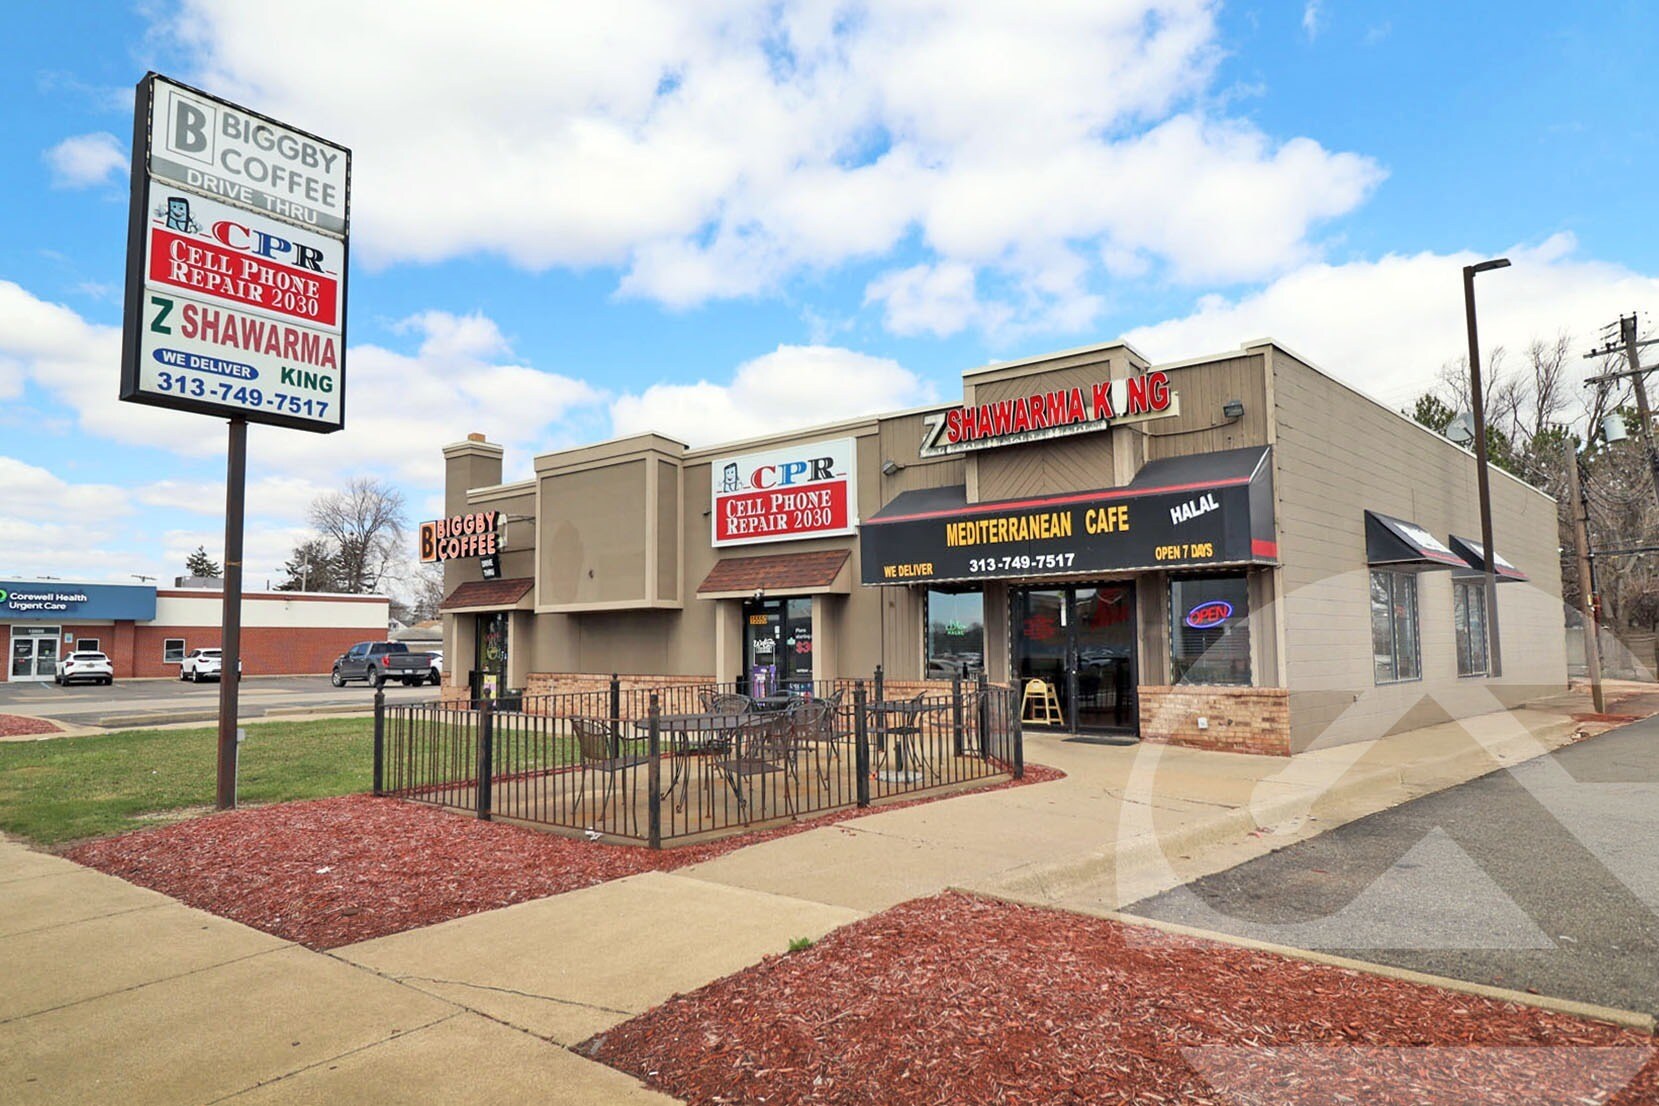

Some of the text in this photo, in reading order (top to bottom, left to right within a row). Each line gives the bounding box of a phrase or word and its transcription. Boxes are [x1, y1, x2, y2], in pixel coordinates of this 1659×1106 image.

[175, 100, 207, 152] B
[222, 112, 337, 174] BIGGBY
[220, 148, 336, 208] COFFEE
[187, 169, 317, 224] DRIVE THRU
[212, 220, 325, 273] CPR
[271, 289, 319, 317] 2030
[150, 296, 337, 370] Z SHAWARMA
[162, 350, 251, 378] WE DELIVER
[281, 366, 333, 393] KING
[157, 372, 328, 418] 313-749-7517
[919, 411, 947, 459] Z
[947, 386, 1086, 444] SHAWARMA
[750, 456, 835, 489] CPR
[794, 507, 832, 528] 2030
[1170, 493, 1220, 525] HALAL
[437, 510, 496, 539] BIGGBY
[946, 505, 1130, 547] MEDITERRANEAN CAFE
[422, 526, 434, 558] B
[438, 533, 496, 559] COFFEE
[1155, 543, 1213, 561] OPEN 7 DAYS
[883, 563, 934, 578] WE DELIVER
[969, 553, 1075, 573] 313-749-7517
[9, 602, 67, 611] Urgent Care
[10, 592, 87, 602] Corewell Health
[1189, 605, 1228, 626] OPEN
